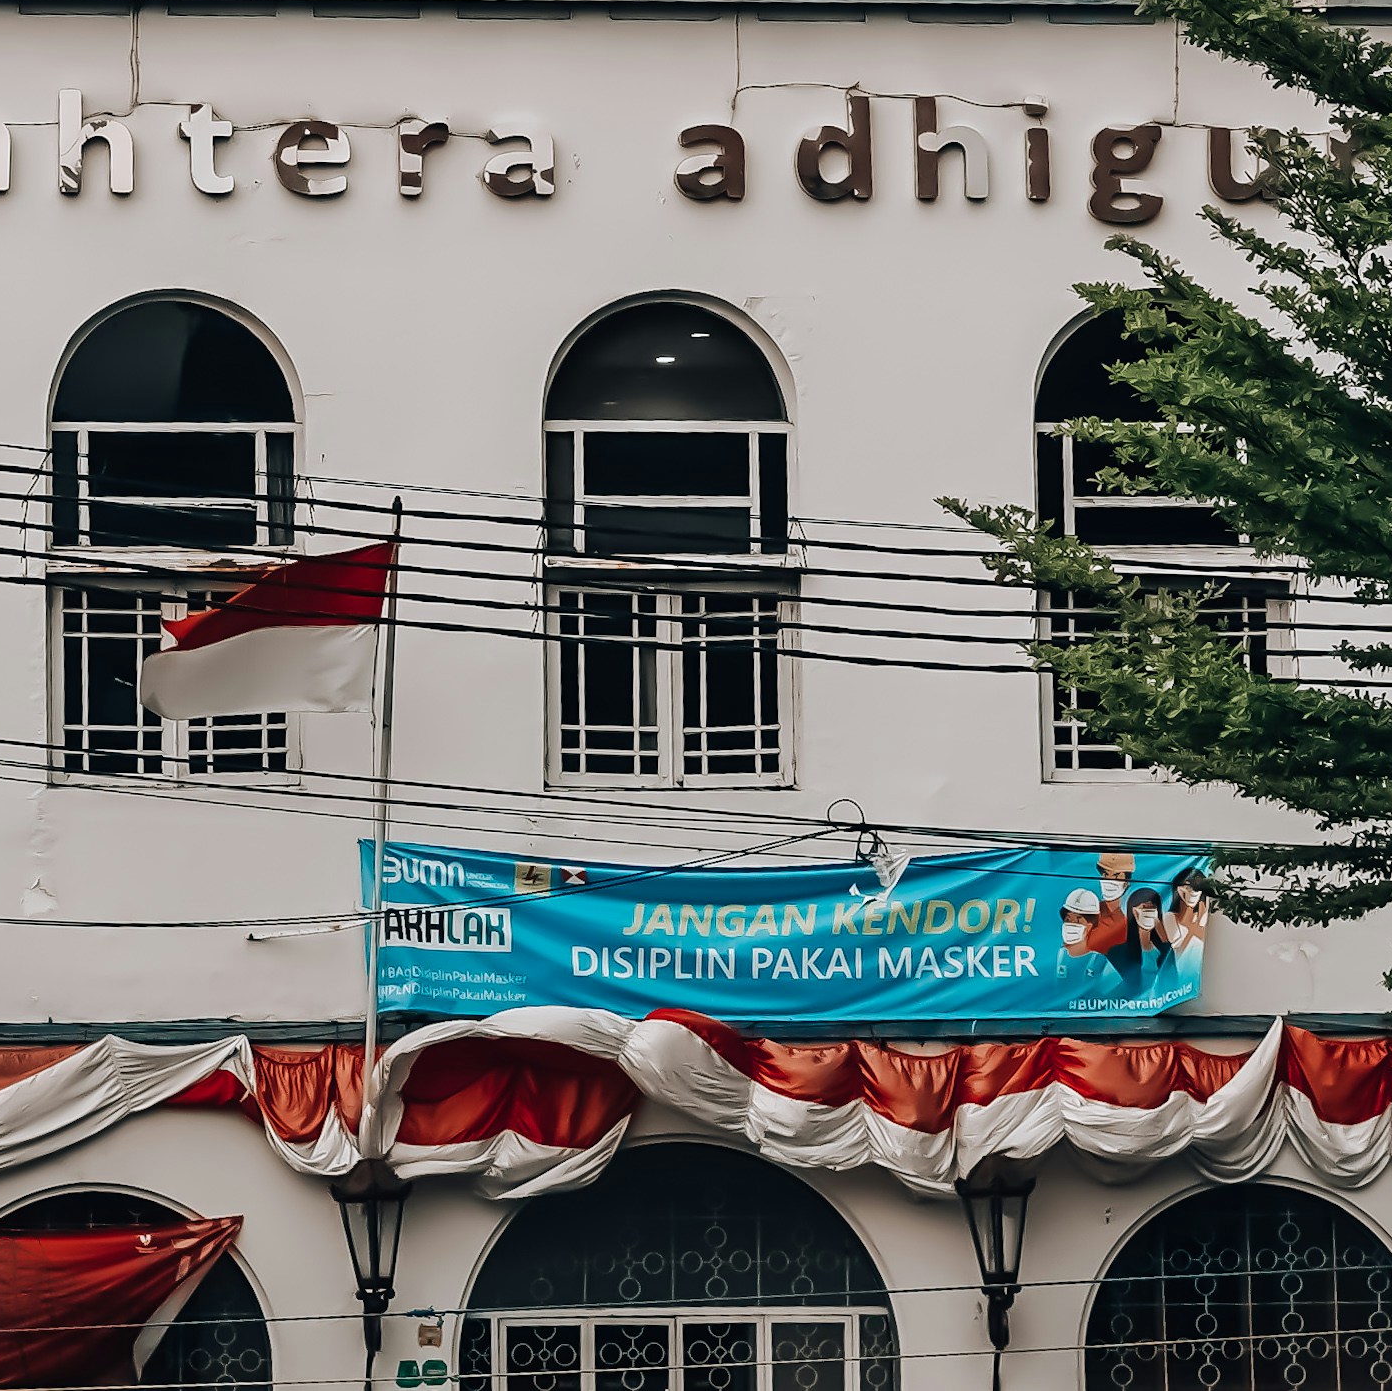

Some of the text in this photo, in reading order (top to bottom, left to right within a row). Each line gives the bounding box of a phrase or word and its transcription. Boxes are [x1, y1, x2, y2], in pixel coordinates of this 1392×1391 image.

[384, 908, 506, 947] AKHLAK
[622, 898, 1037, 938] JANGAN KENDOR!
[571, 944, 1040, 980] DISIPLIN PAKAI MASKER
